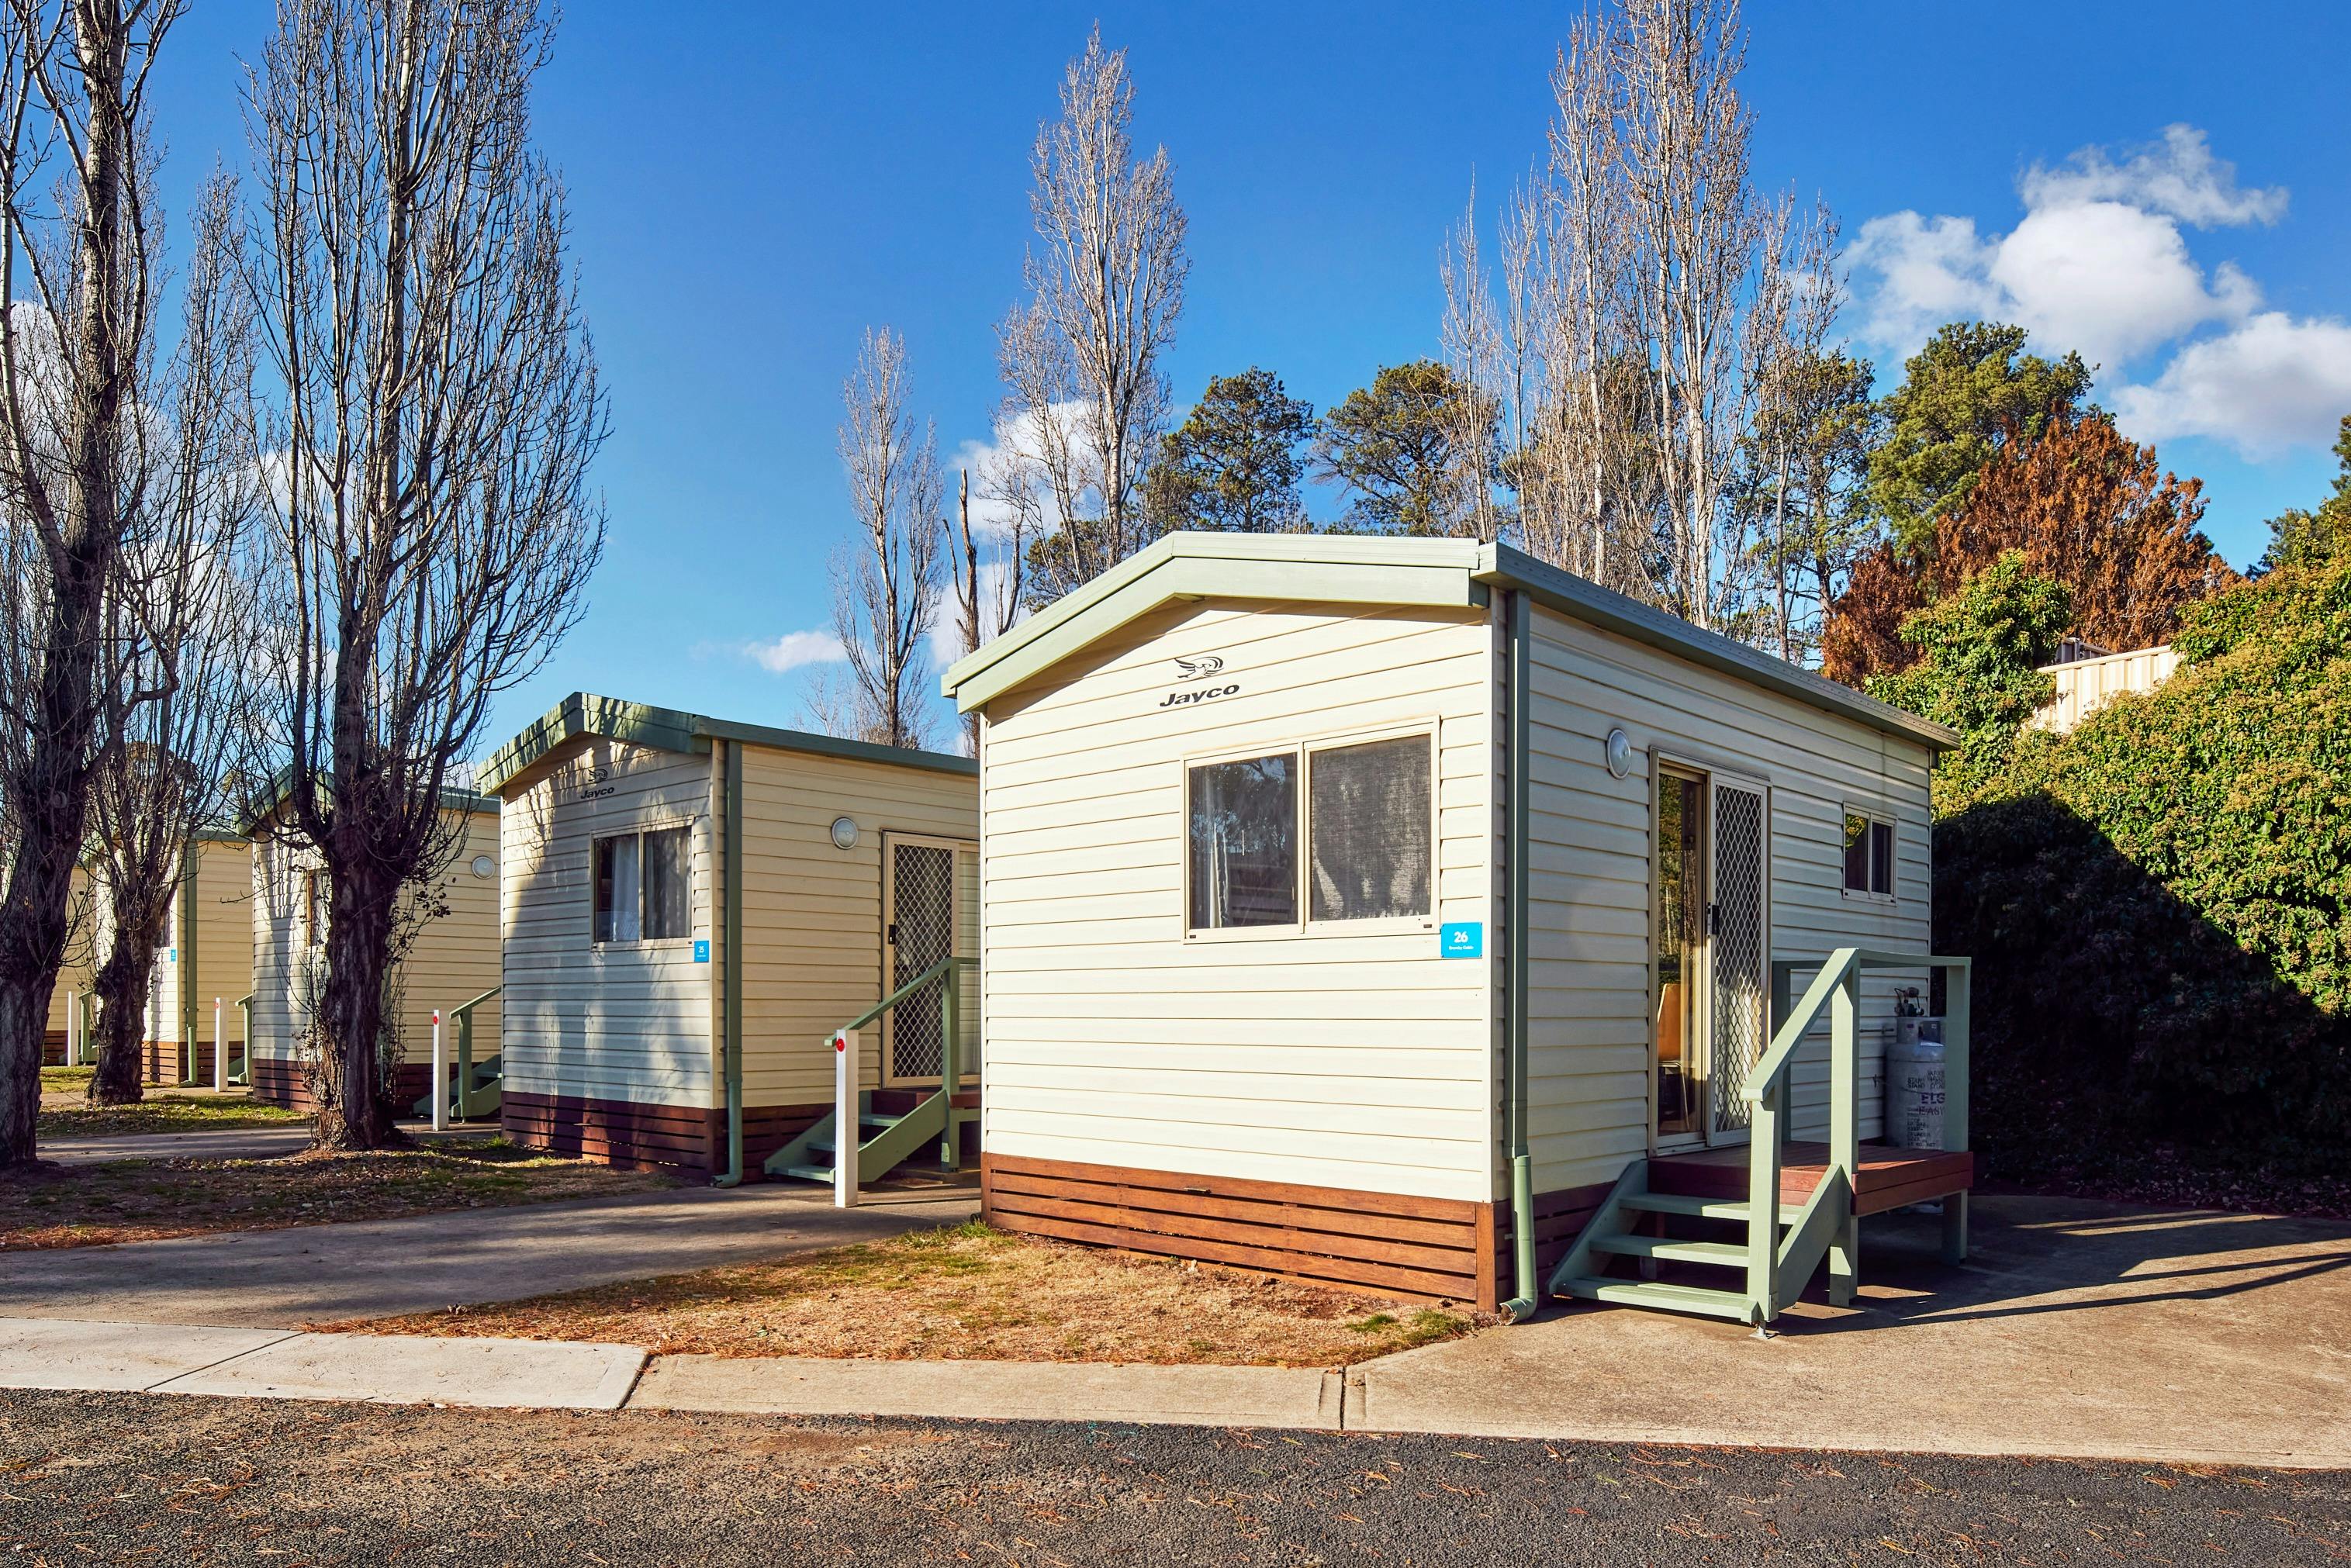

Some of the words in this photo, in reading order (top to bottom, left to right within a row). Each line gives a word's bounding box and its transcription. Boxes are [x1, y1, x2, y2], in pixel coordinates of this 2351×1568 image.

[1160, 685, 1239, 707] Jayco
[580, 787, 615, 799] Jayco
[1454, 931, 1468, 943] 26
